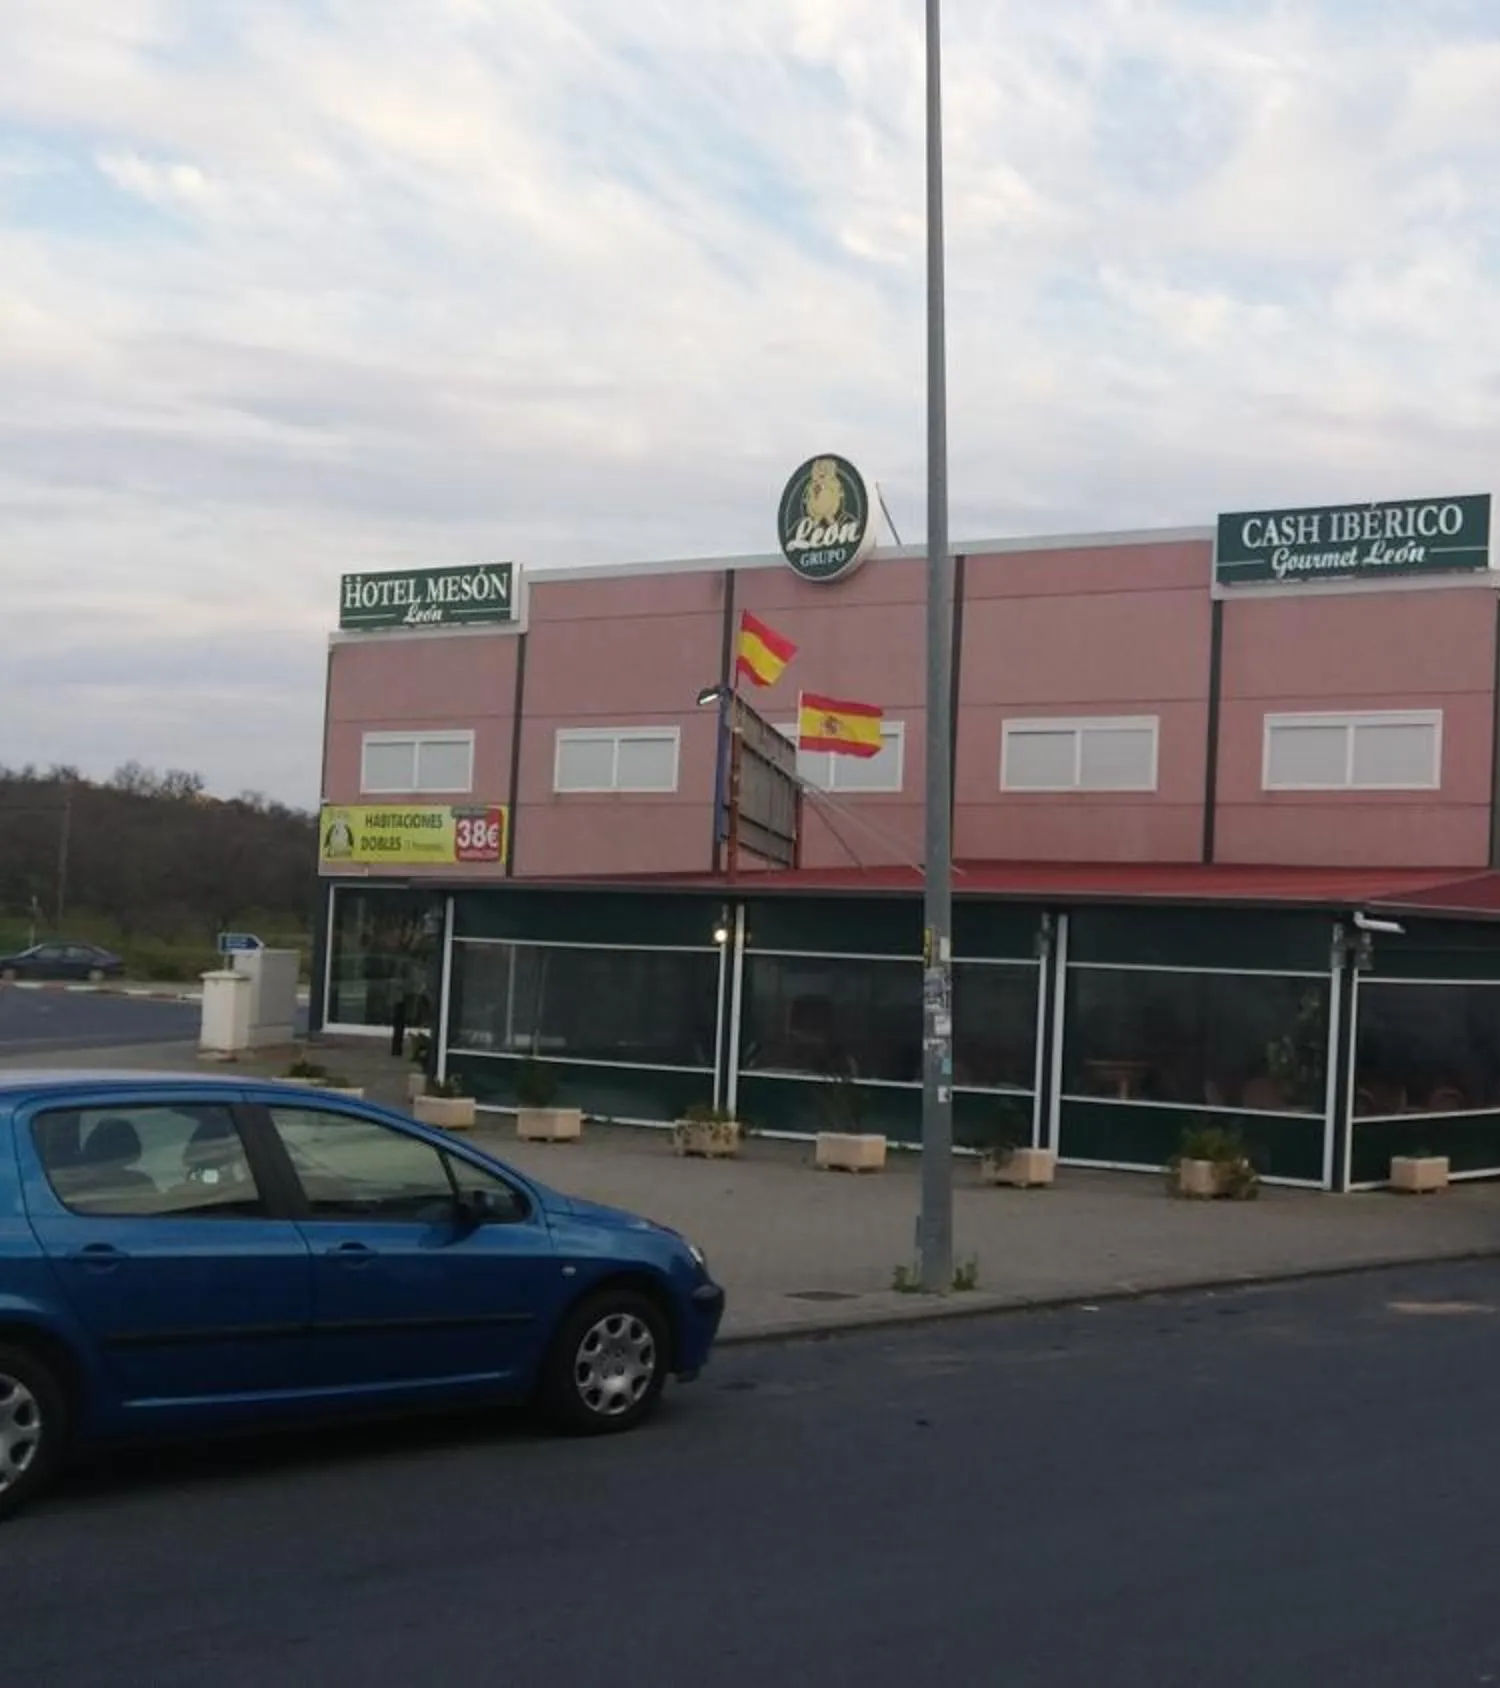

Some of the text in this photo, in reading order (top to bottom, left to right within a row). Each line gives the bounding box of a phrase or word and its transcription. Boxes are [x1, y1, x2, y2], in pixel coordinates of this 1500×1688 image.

[785, 516, 860, 552] León
[1241, 500, 1464, 548] CASH IBÉRICO
[801, 548, 847, 567] GRUPO
[1271, 538, 1426, 578] Gourmet León
[344, 567, 508, 608] HOTEL MESÓN
[402, 603, 444, 623] León
[365, 813, 443, 829] HABITACIONES
[457, 819, 499, 849] 38€
[360, 836, 401, 851] DOBLES
